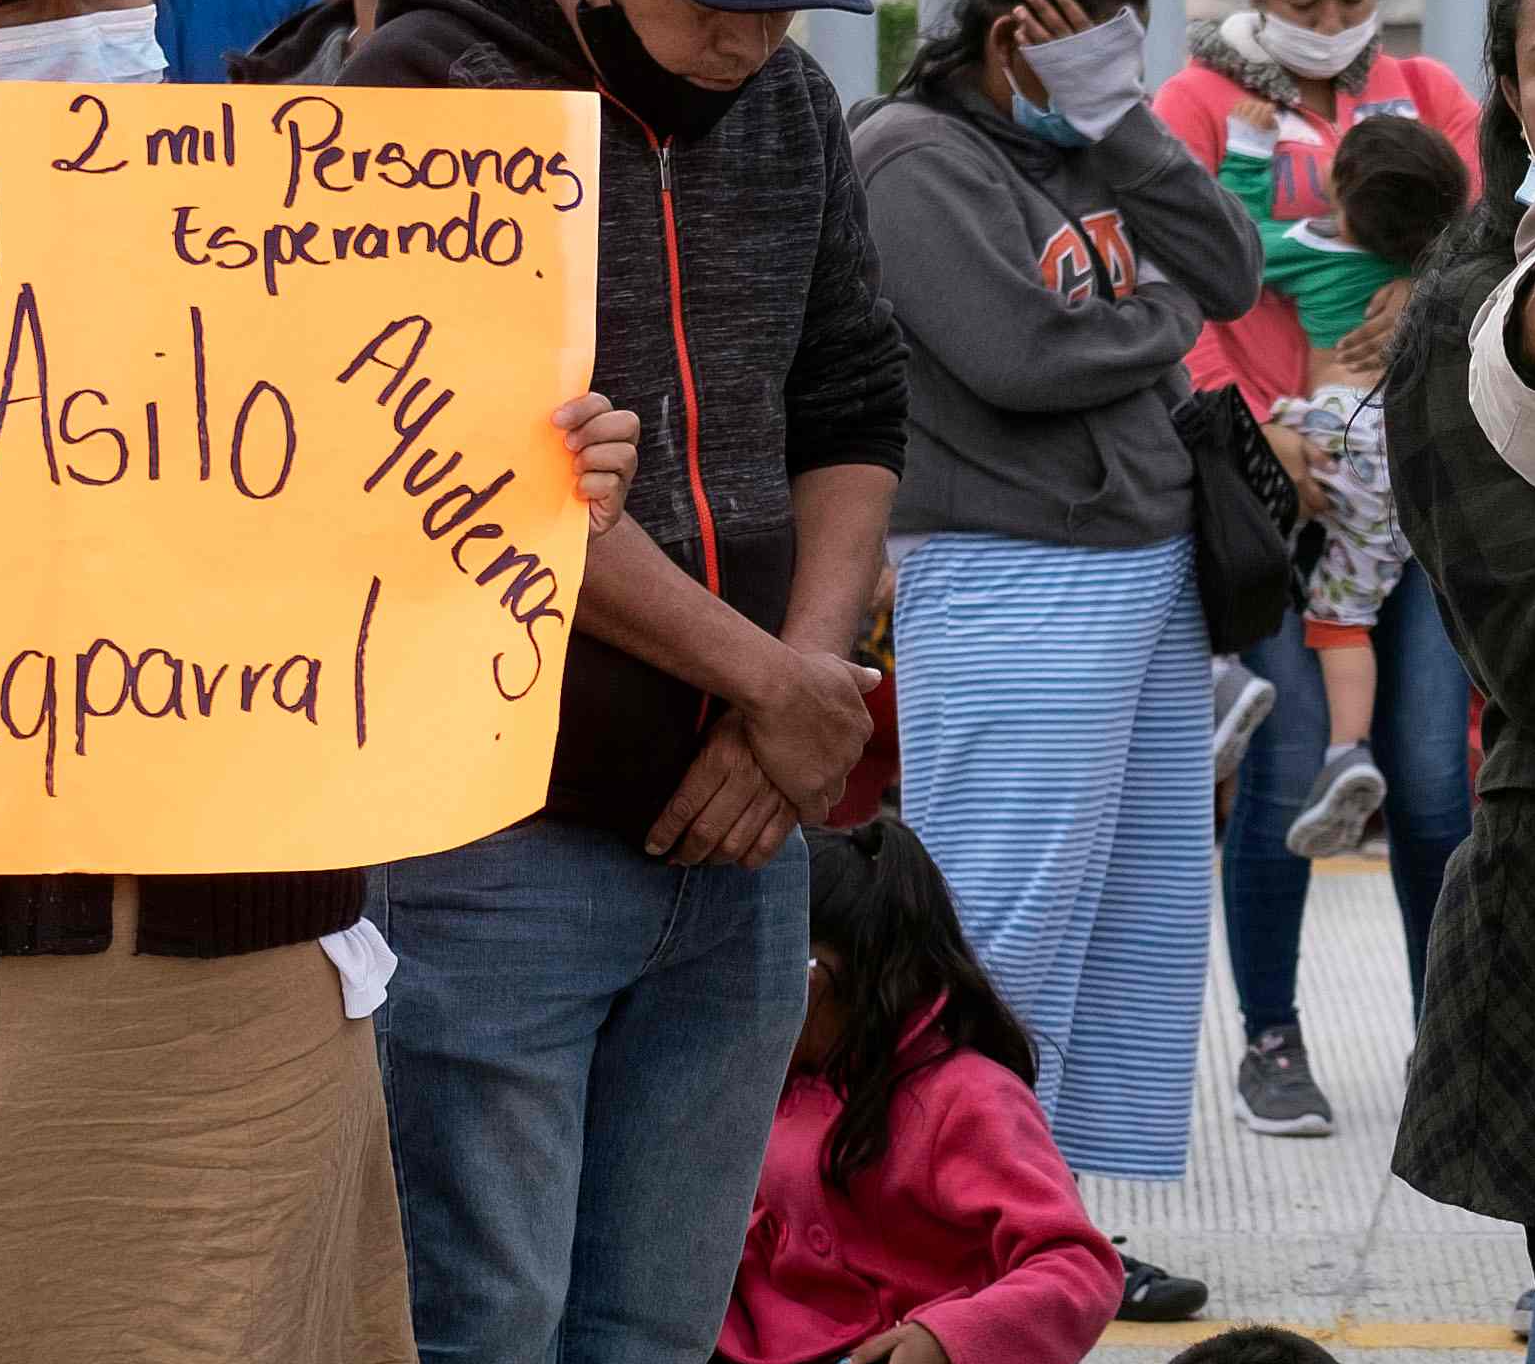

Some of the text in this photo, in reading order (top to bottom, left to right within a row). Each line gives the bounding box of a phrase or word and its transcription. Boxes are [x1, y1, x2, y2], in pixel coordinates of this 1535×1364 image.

[52, 95, 582, 212] 2 mil Personas
